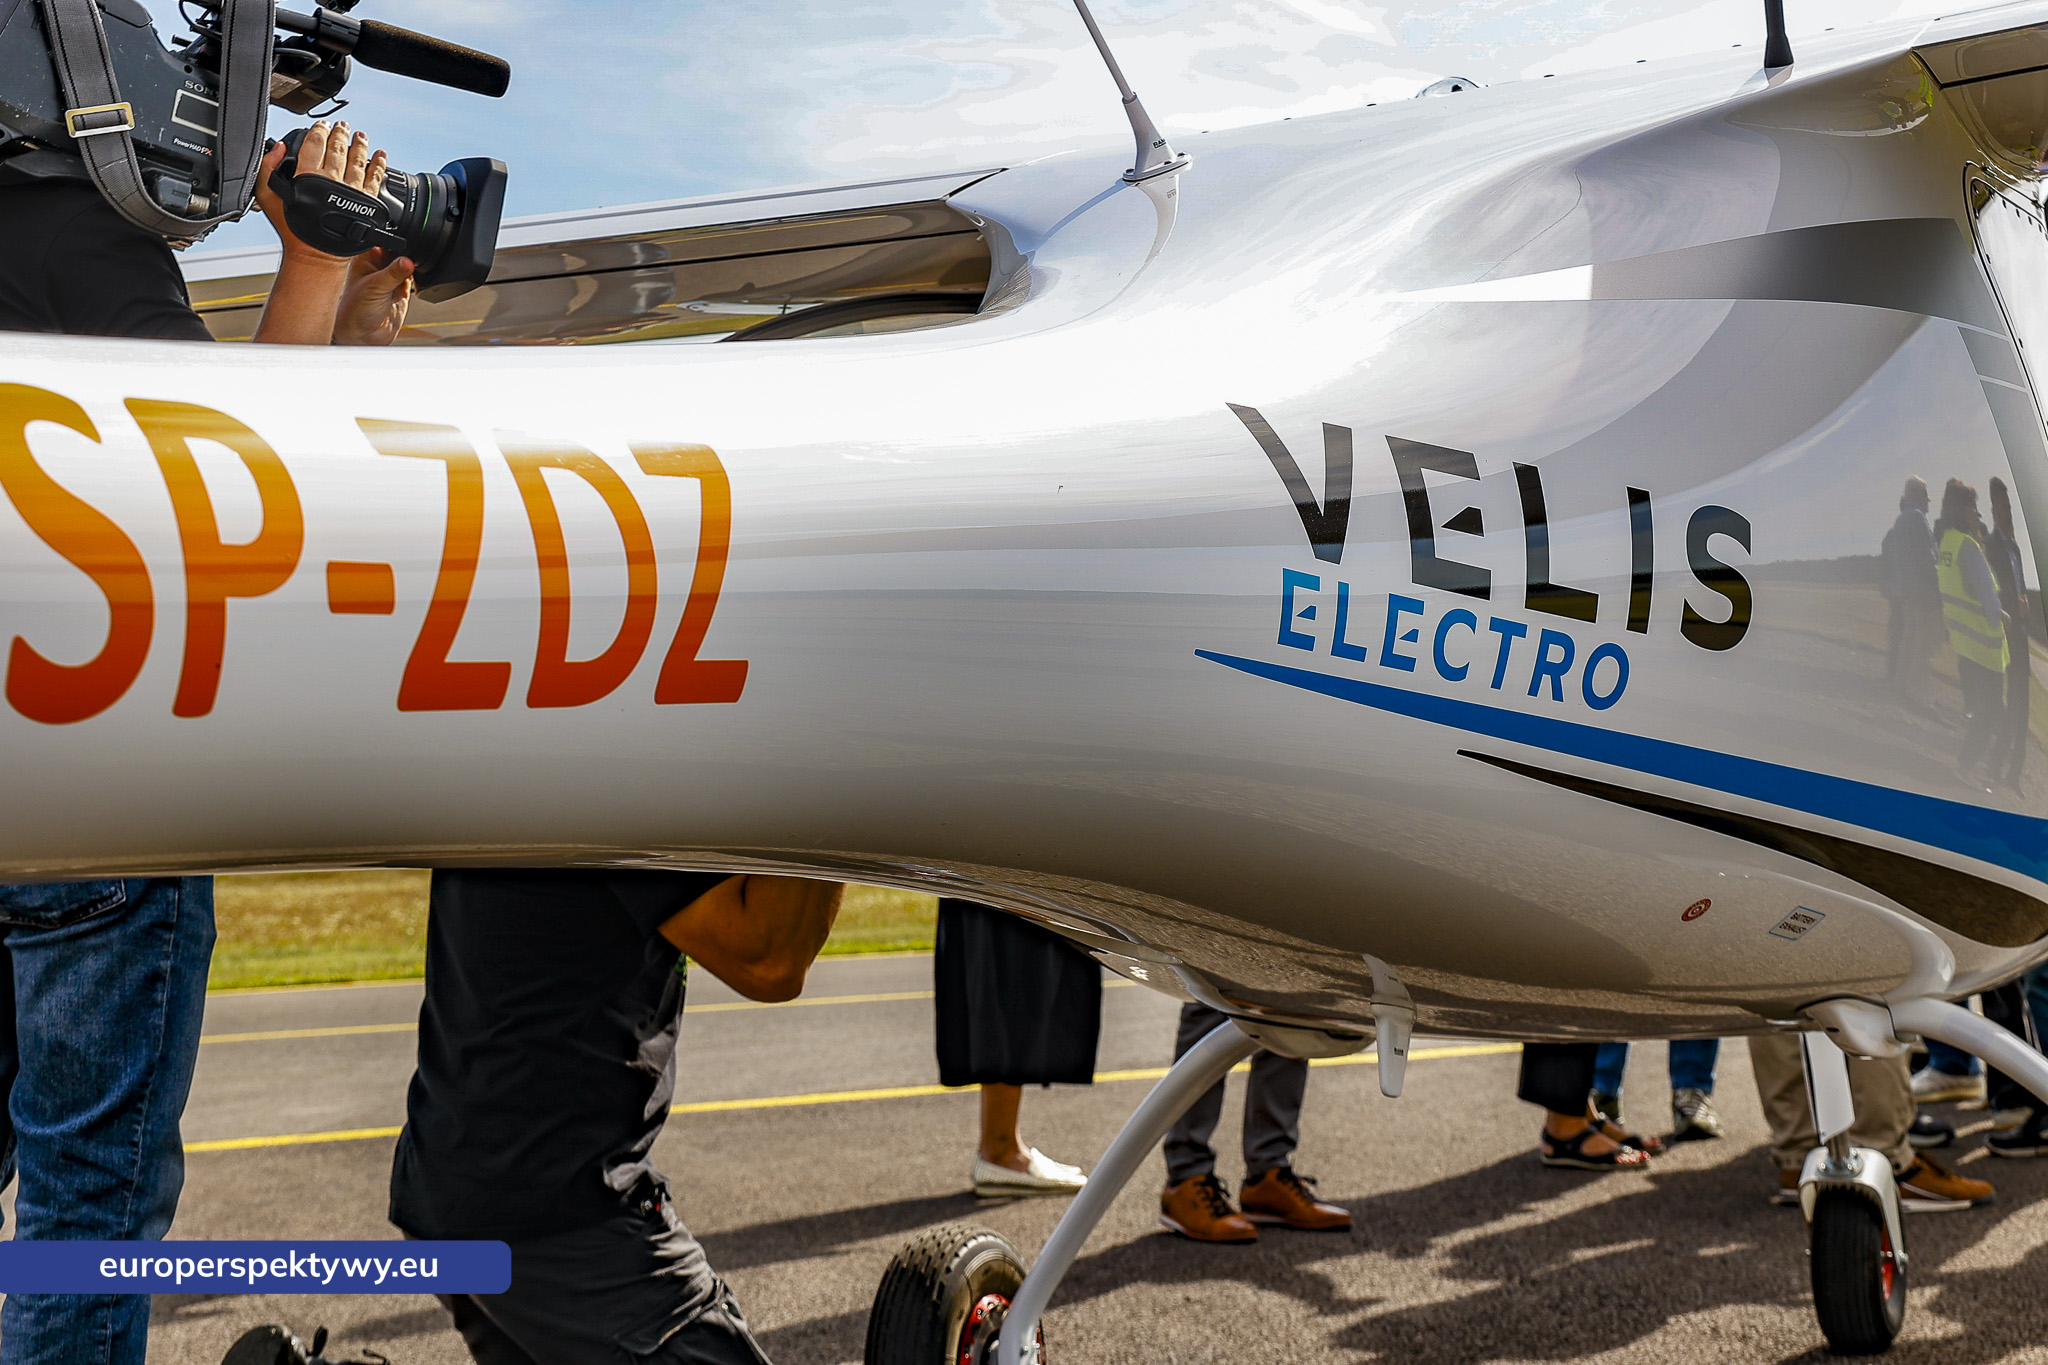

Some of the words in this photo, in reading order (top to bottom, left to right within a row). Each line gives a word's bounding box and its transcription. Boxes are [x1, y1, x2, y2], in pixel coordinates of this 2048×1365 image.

[327, 194, 376, 217] FUJINON
[0, 376, 749, 726] SP-ZDZ
[1226, 402, 1753, 652] VELIS
[1277, 567, 1630, 711] ELECTRO
